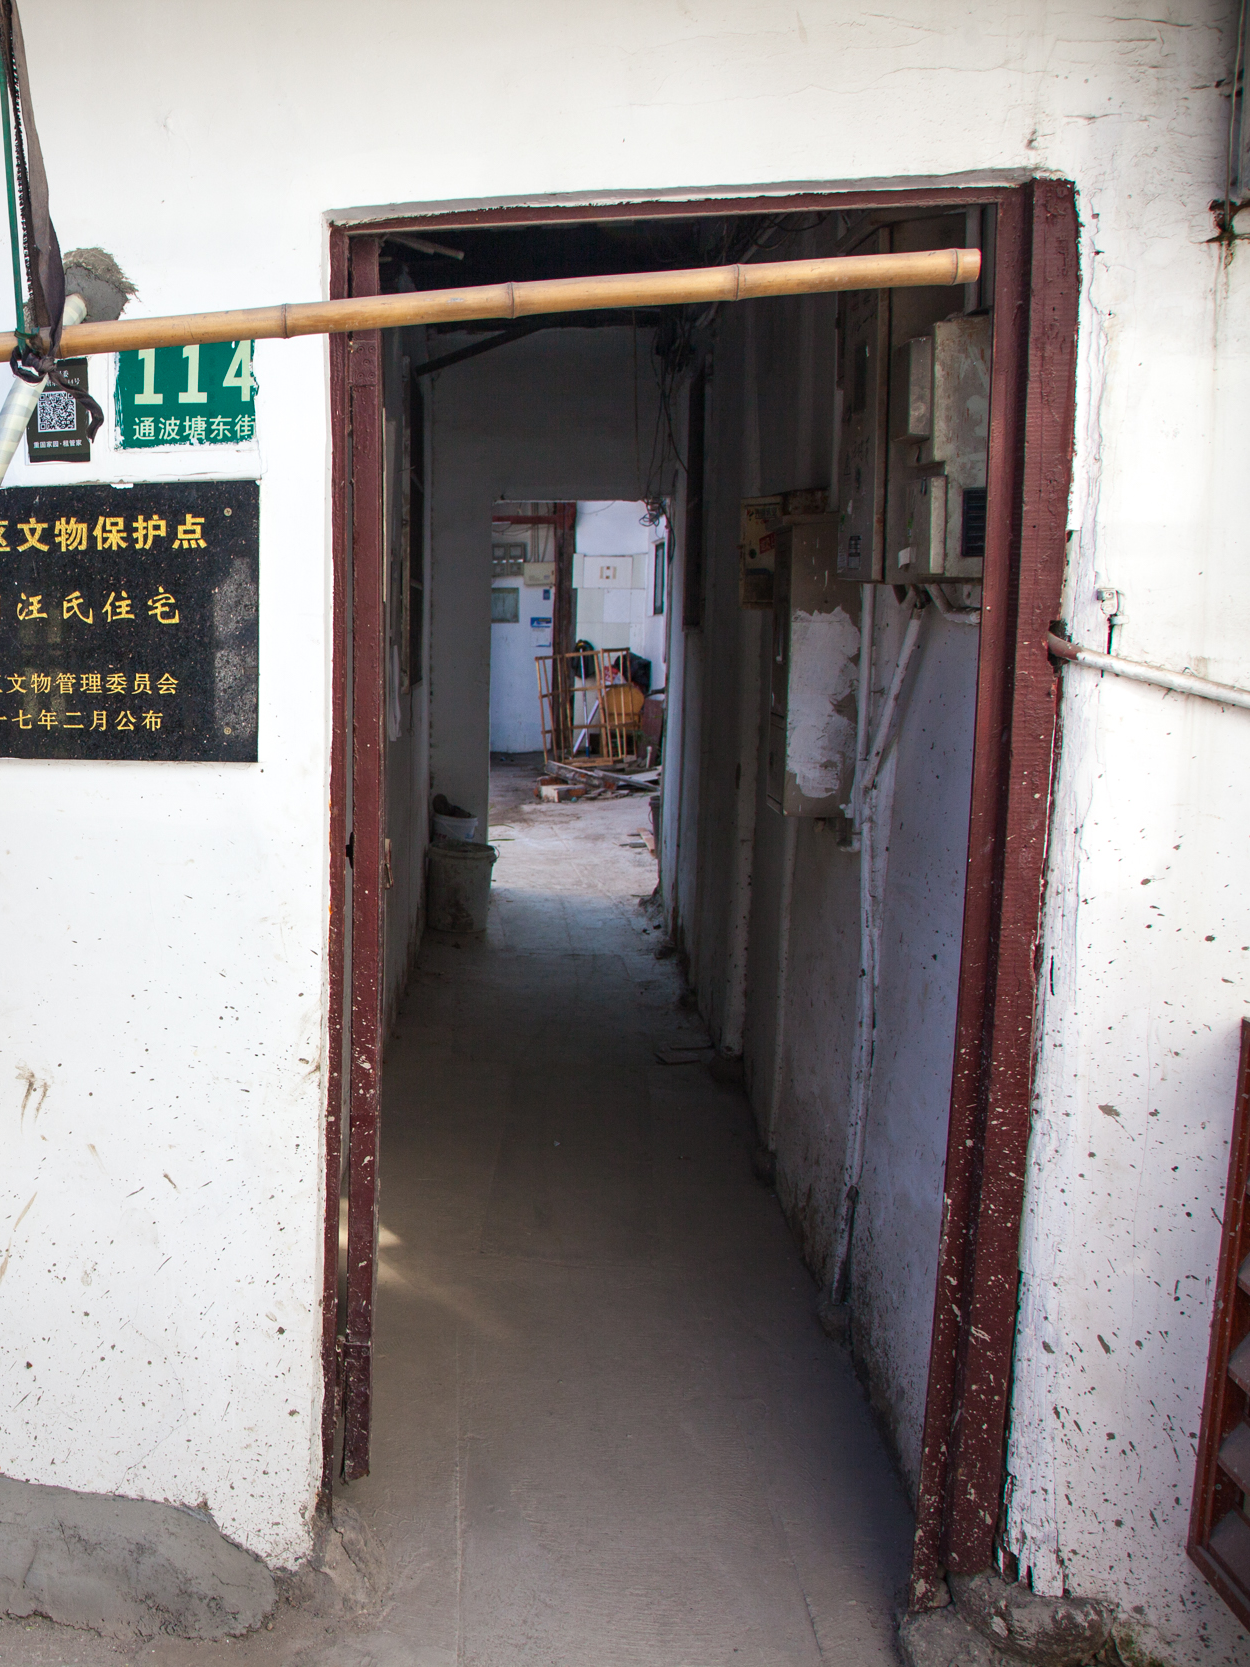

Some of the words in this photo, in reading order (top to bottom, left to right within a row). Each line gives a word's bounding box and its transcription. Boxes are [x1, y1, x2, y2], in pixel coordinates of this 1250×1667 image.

[134, 339, 255, 405] 114
[133, 414, 255, 440] 通波塘东街
